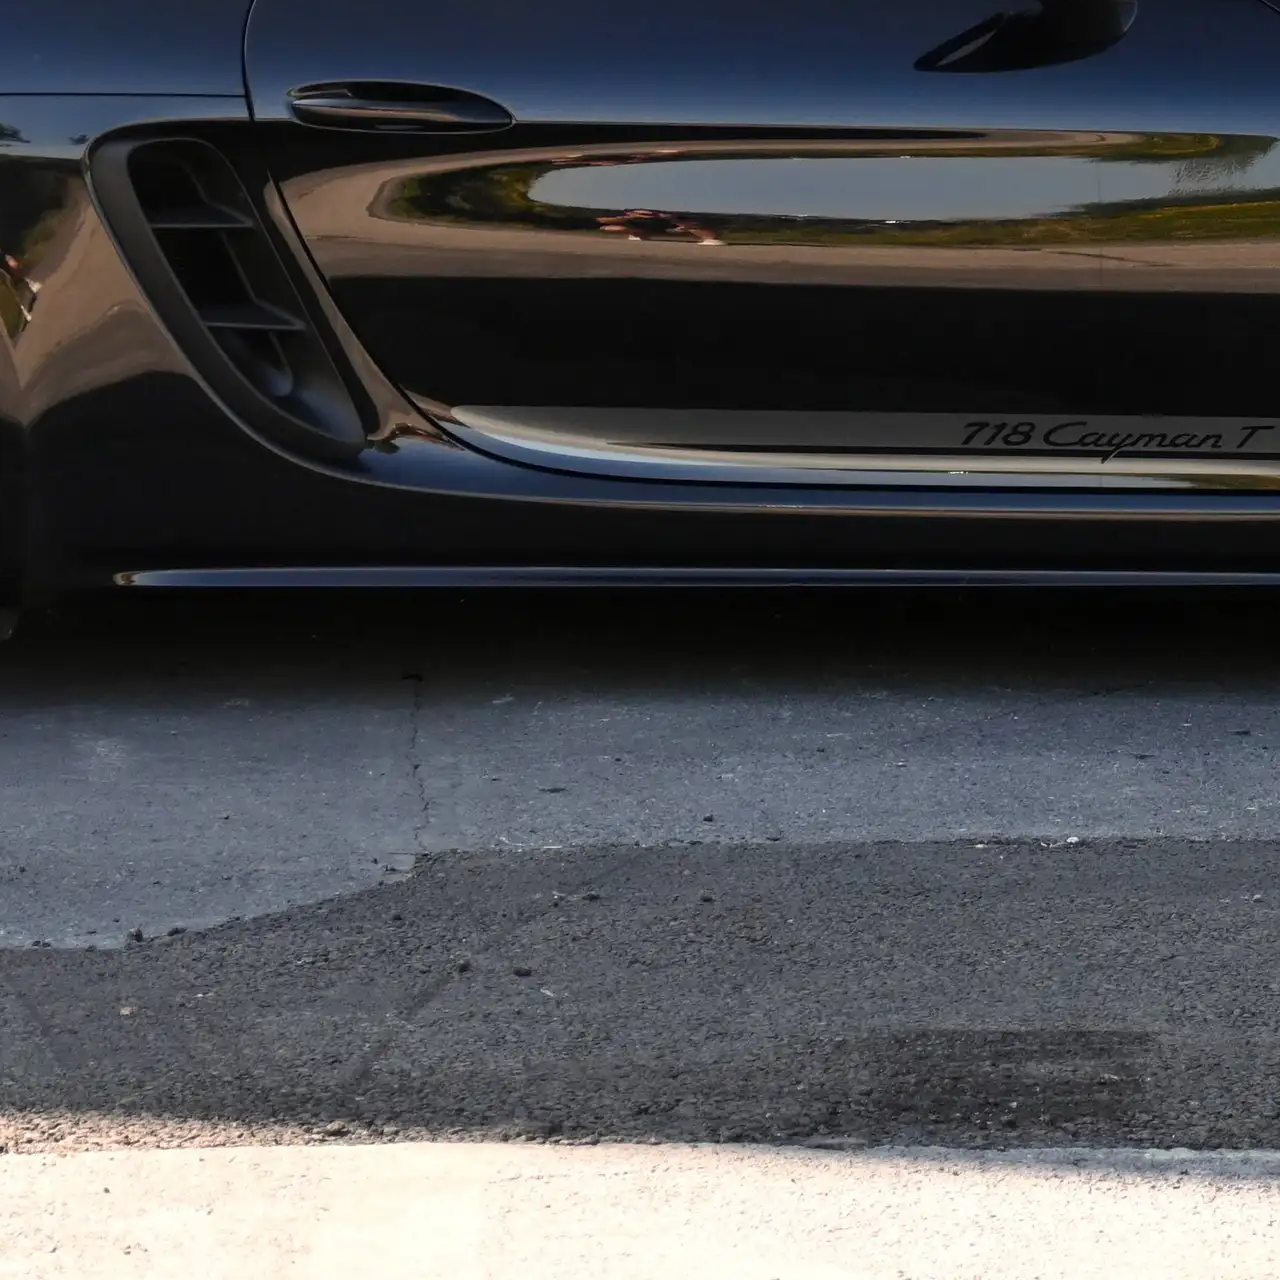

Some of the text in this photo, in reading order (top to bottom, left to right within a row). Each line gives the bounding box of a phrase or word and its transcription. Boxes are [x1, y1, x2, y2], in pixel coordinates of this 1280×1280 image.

[960, 421, 1276, 465] 718 Cayman T
